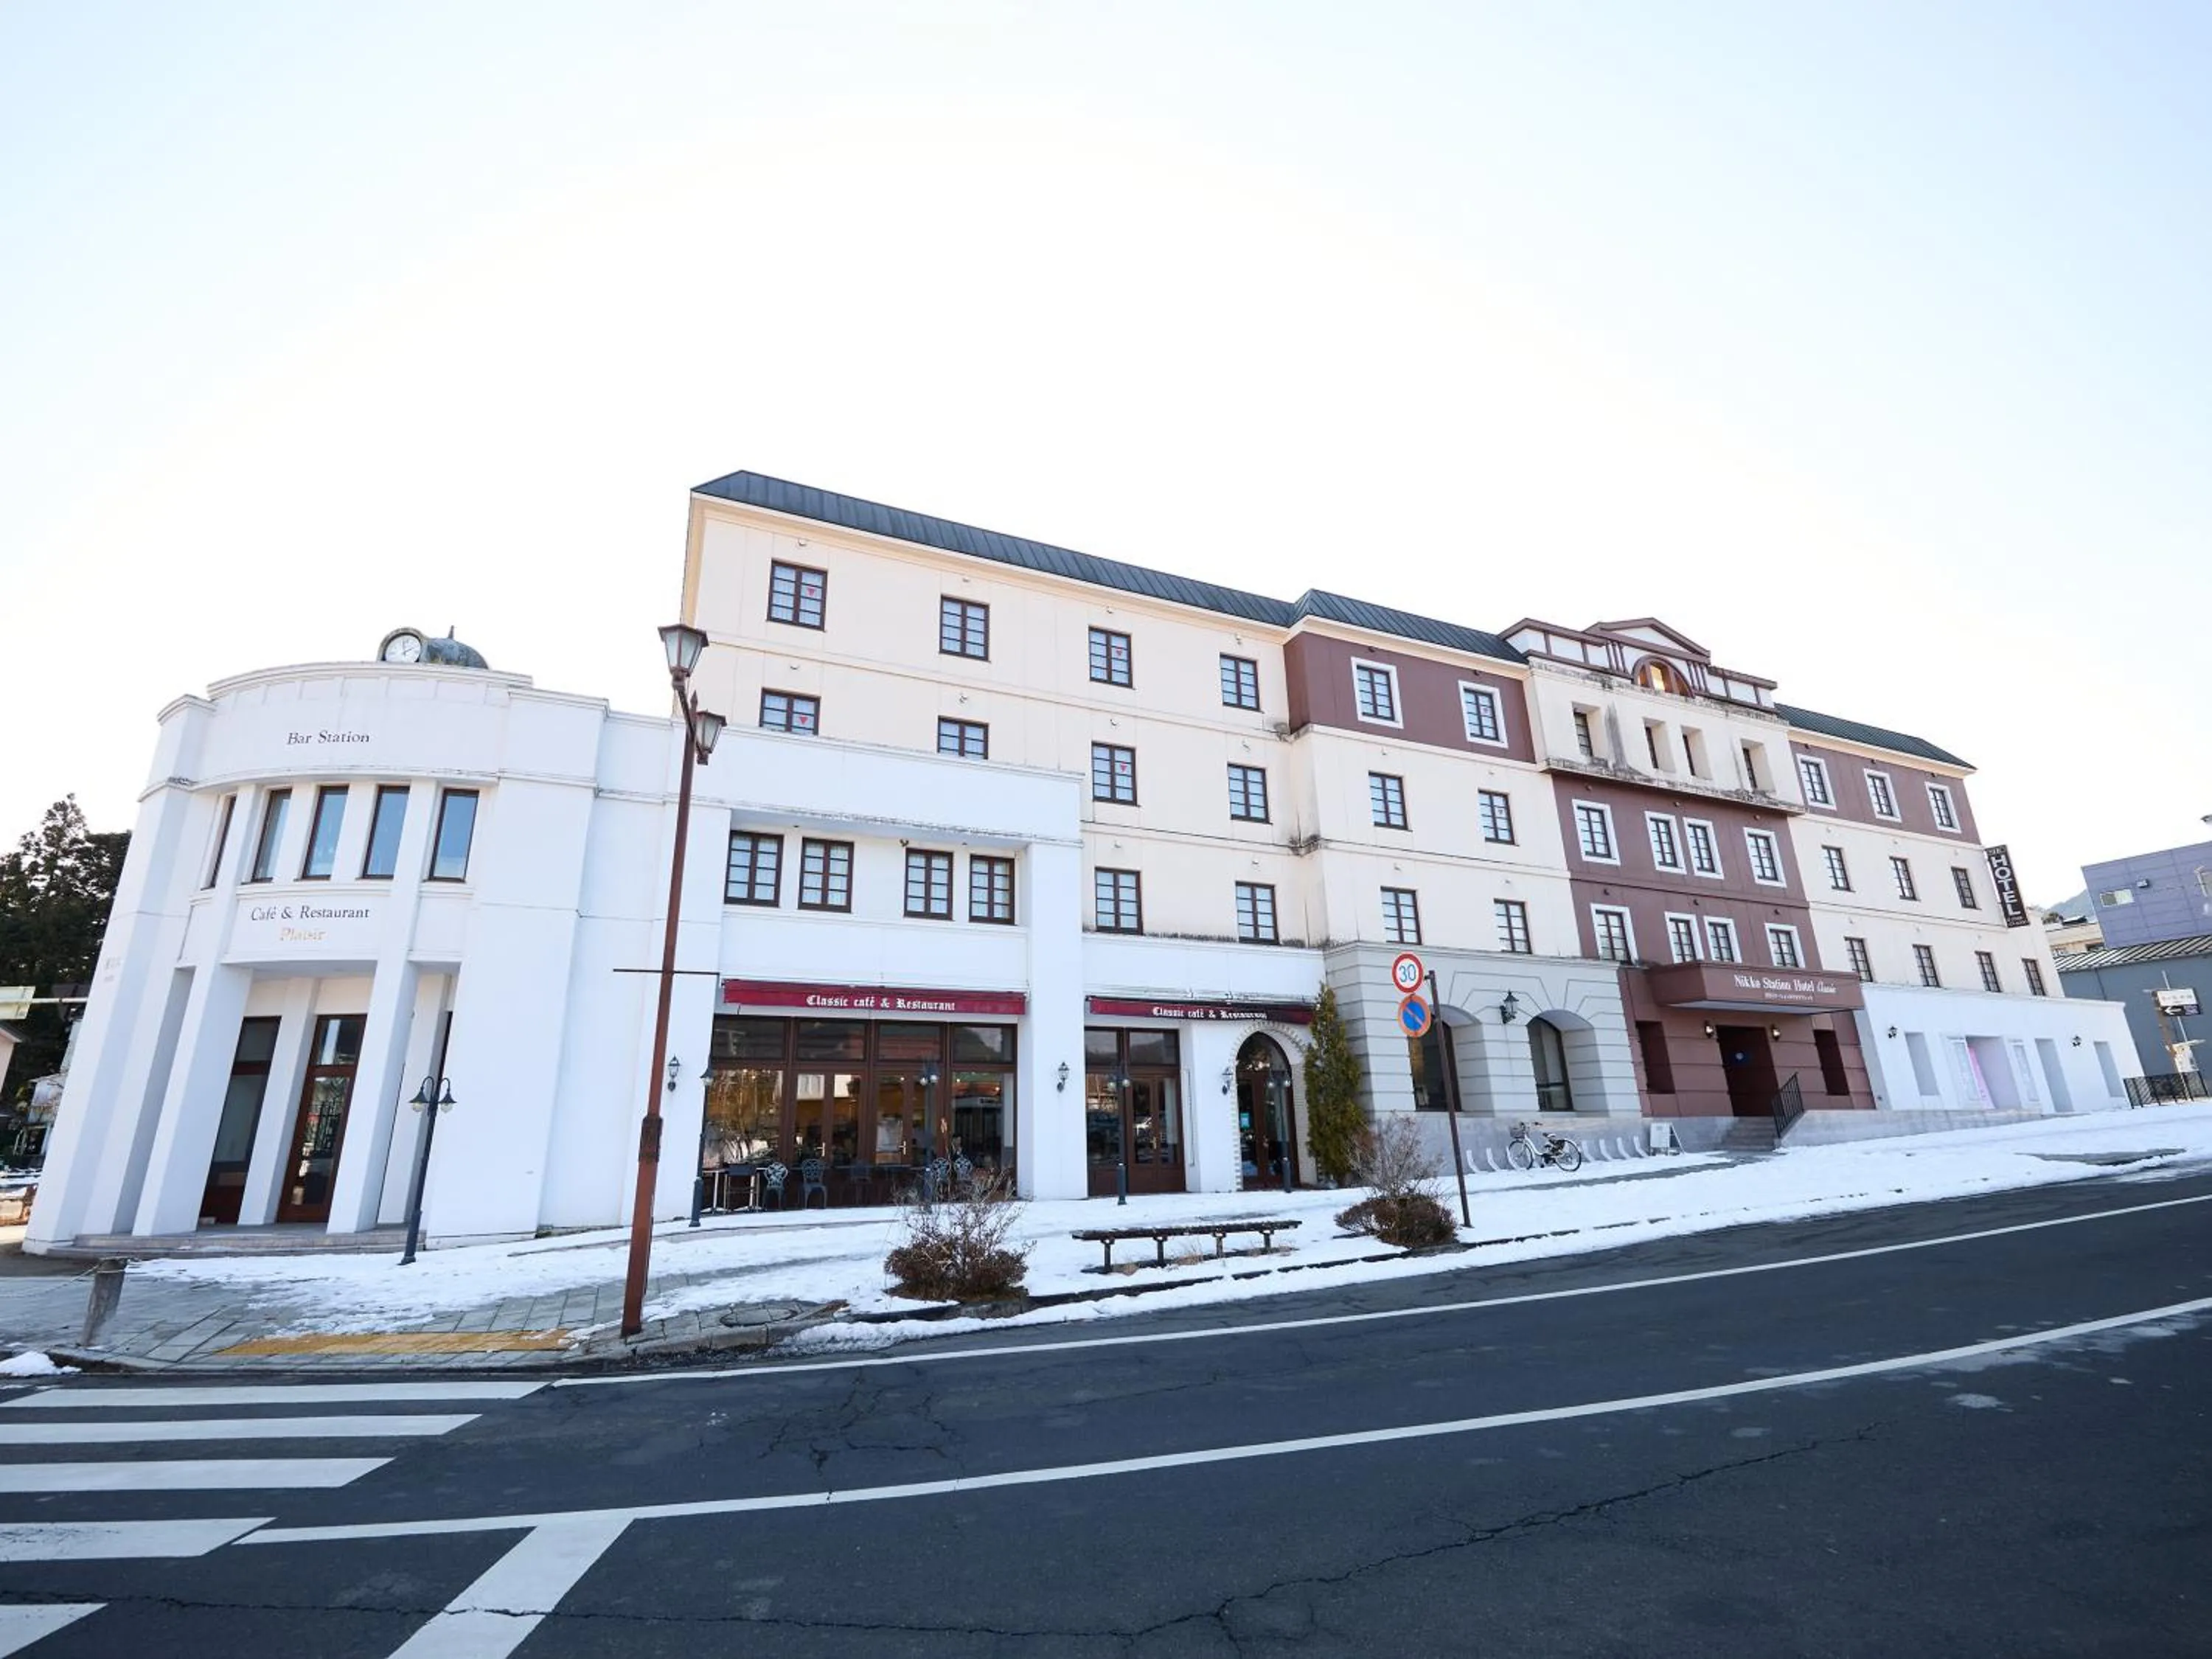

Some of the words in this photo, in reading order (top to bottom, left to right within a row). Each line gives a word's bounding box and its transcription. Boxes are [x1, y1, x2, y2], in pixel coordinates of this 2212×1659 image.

[288, 732, 312, 745] Bar
[318, 730, 369, 743] Station
[1992, 855, 2020, 915] HOTEL
[251, 906, 276, 920] Café
[281, 906, 292, 919] &
[300, 905, 369, 919] Restaurant
[1399, 964, 1416, 982] 30
[1733, 974, 1761, 988] Nikko
[1762, 977, 1792, 990] Station
[1793, 979, 1815, 992] Hotel
[807, 995, 849, 1006] Classic
[854, 996, 875, 1007] café
[880, 998, 890, 1008] &
[897, 998, 956, 1011] Restaurant
[1208, 1009, 1216, 1018] &
